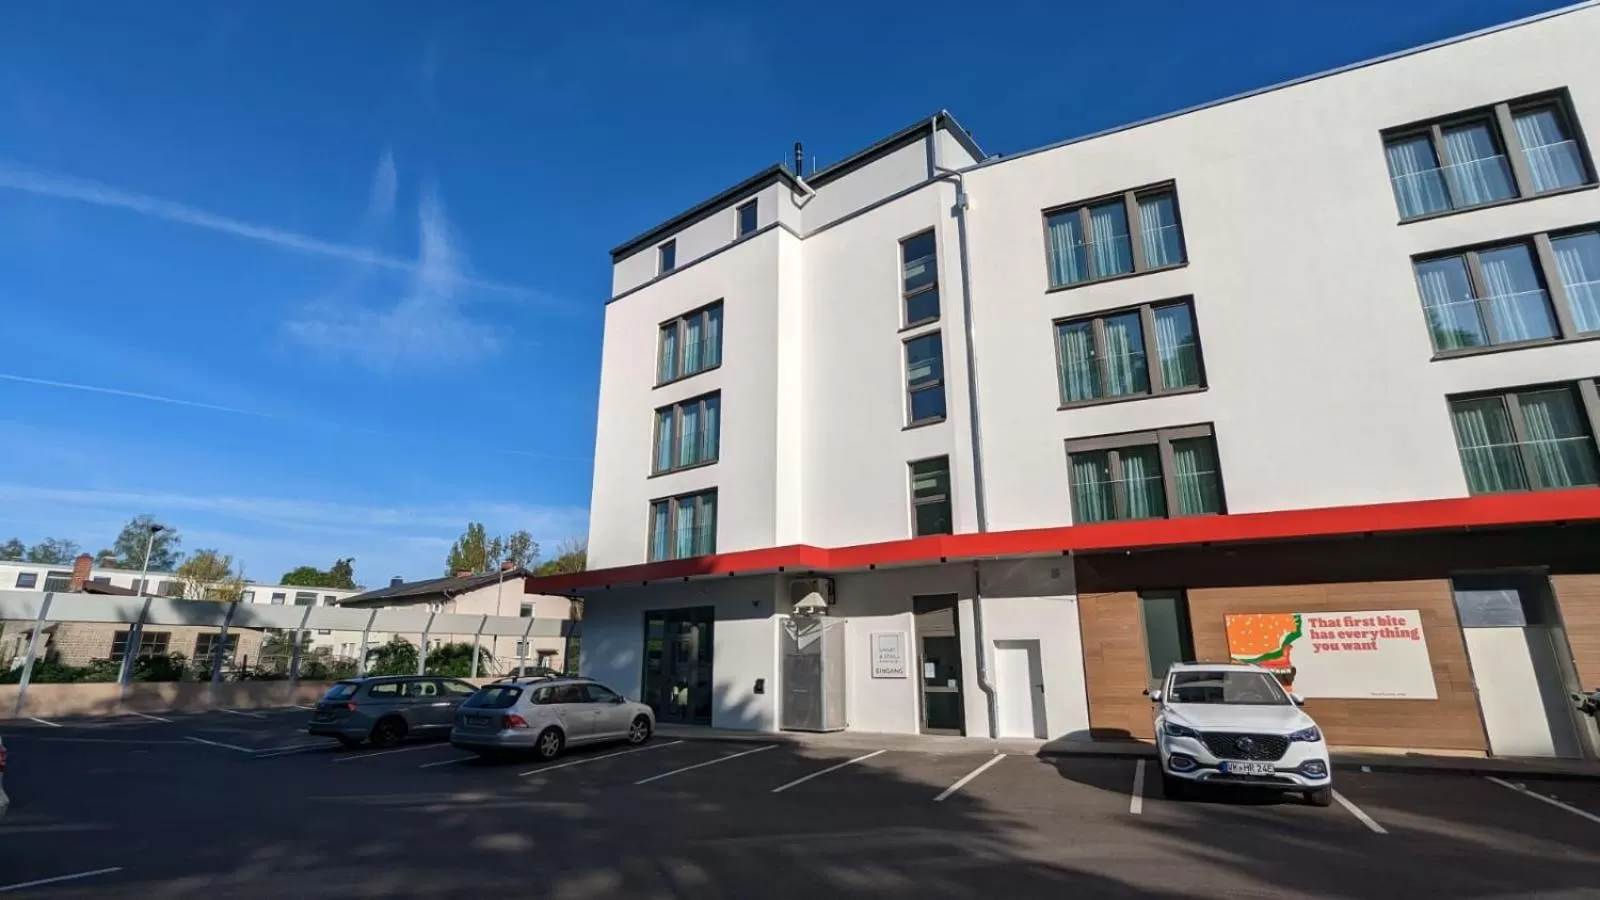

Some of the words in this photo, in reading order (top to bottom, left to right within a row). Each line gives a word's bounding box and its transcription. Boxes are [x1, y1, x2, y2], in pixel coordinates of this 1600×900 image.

[1308, 617, 1342, 628] That
[1343, 616, 1375, 627] first
[1377, 615, 1406, 626] bite
[1310, 629, 1335, 640] has
[1337, 627, 1420, 640] everything
[1312, 643, 1340, 654] you
[1342, 640, 1378, 650] want
